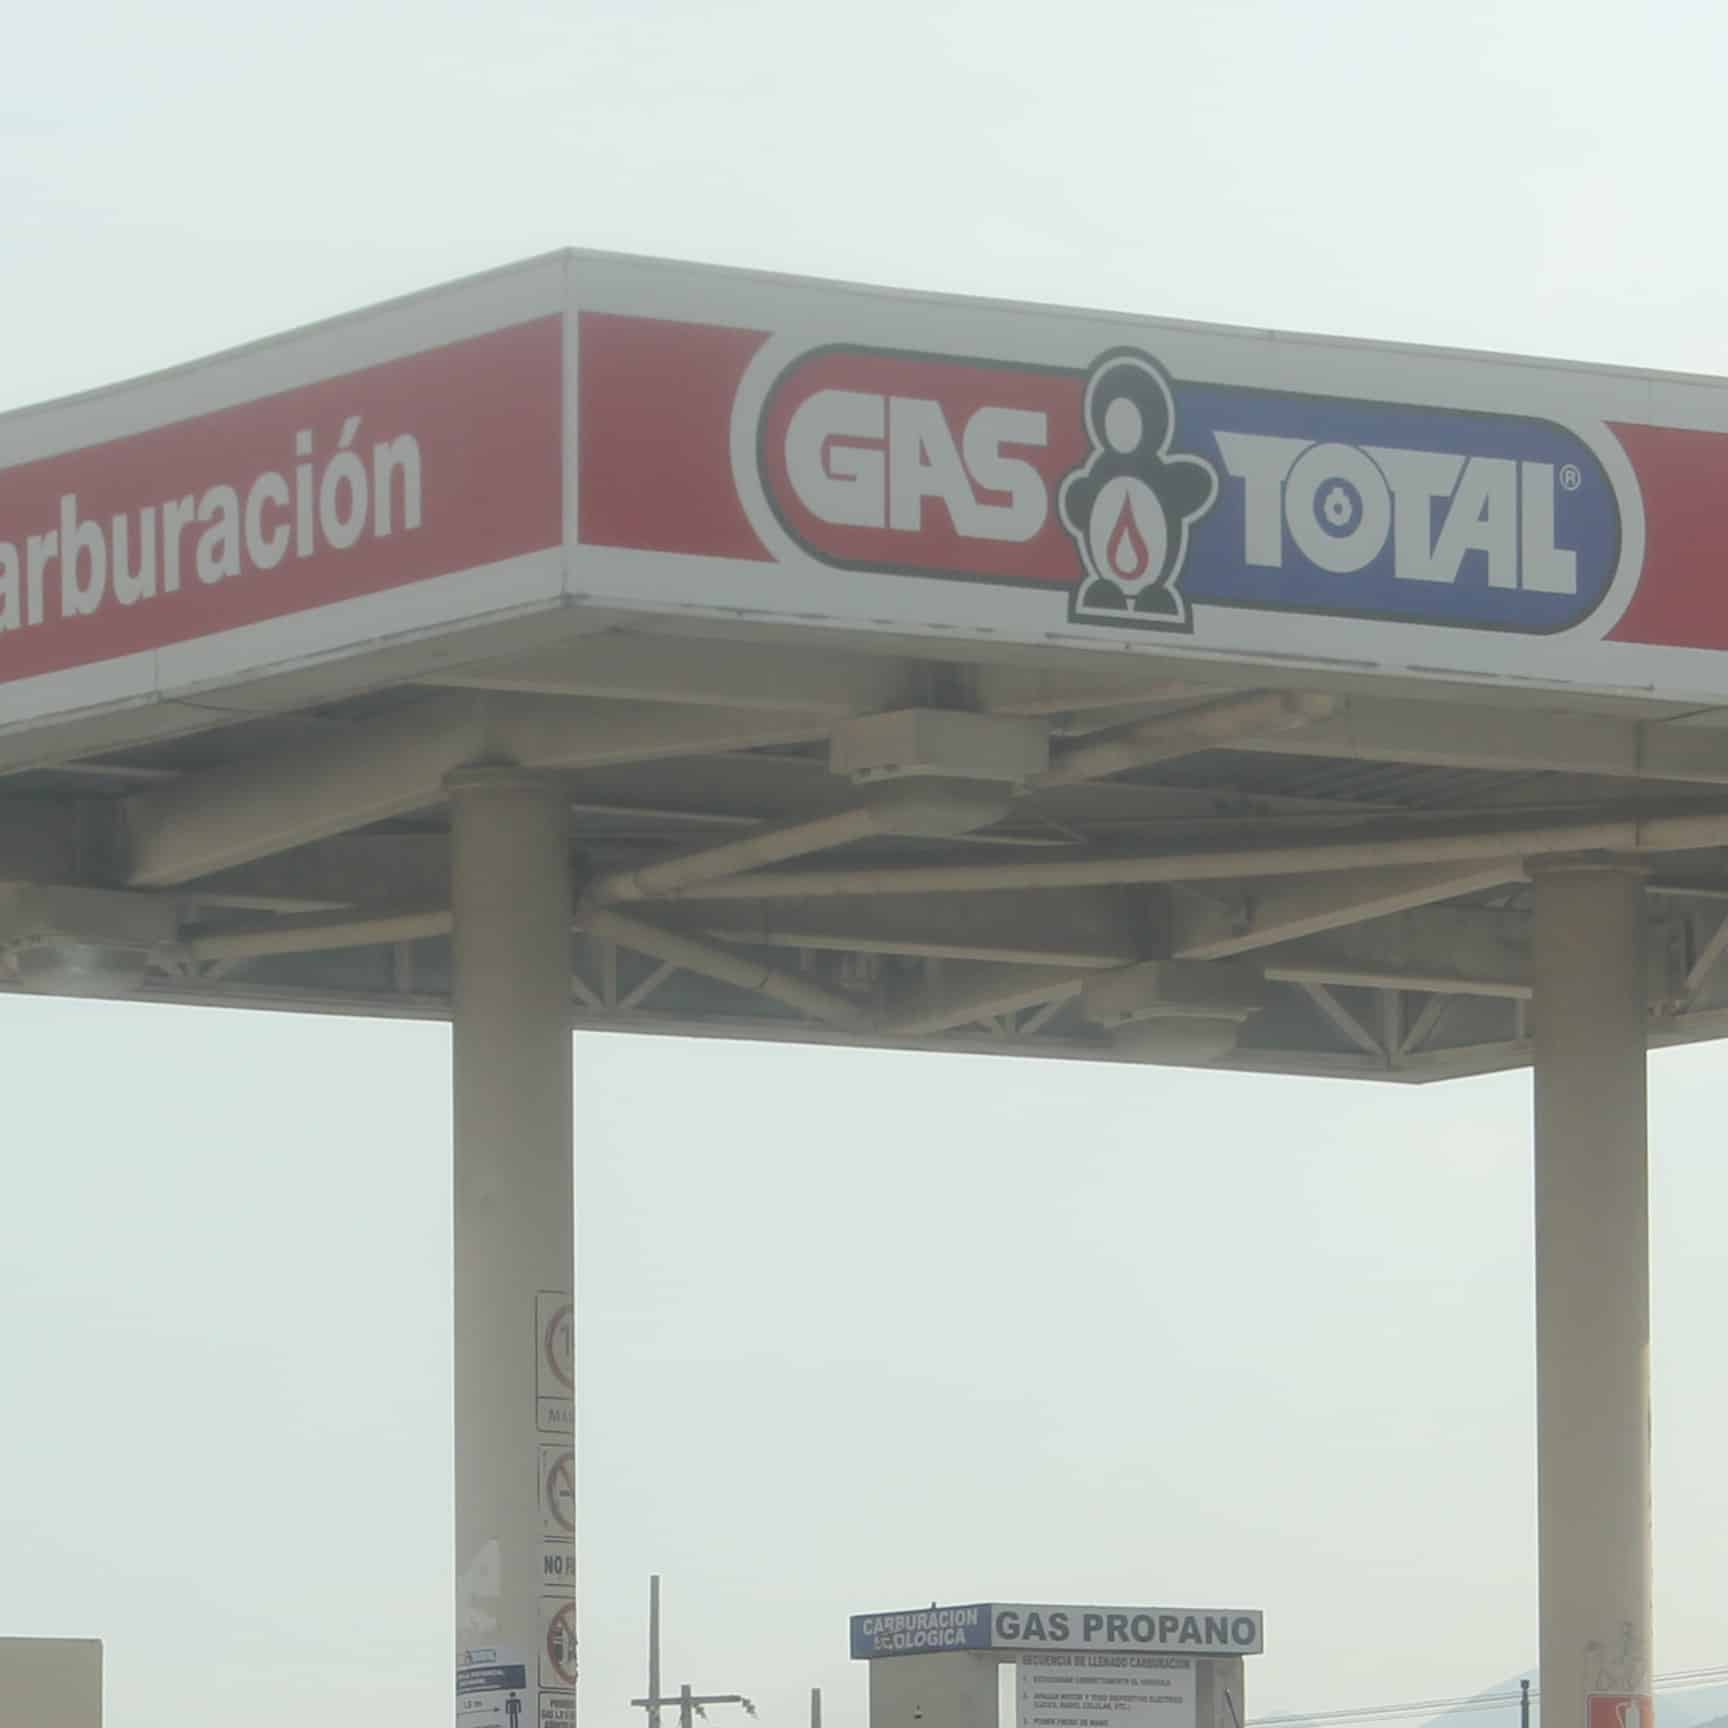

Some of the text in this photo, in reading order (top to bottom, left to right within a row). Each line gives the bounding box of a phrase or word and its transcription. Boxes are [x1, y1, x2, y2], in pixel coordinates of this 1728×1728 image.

[785, 388, 1577, 595] GAS TOTAL
[996, 1611, 1256, 1646] GAS PROPANO
